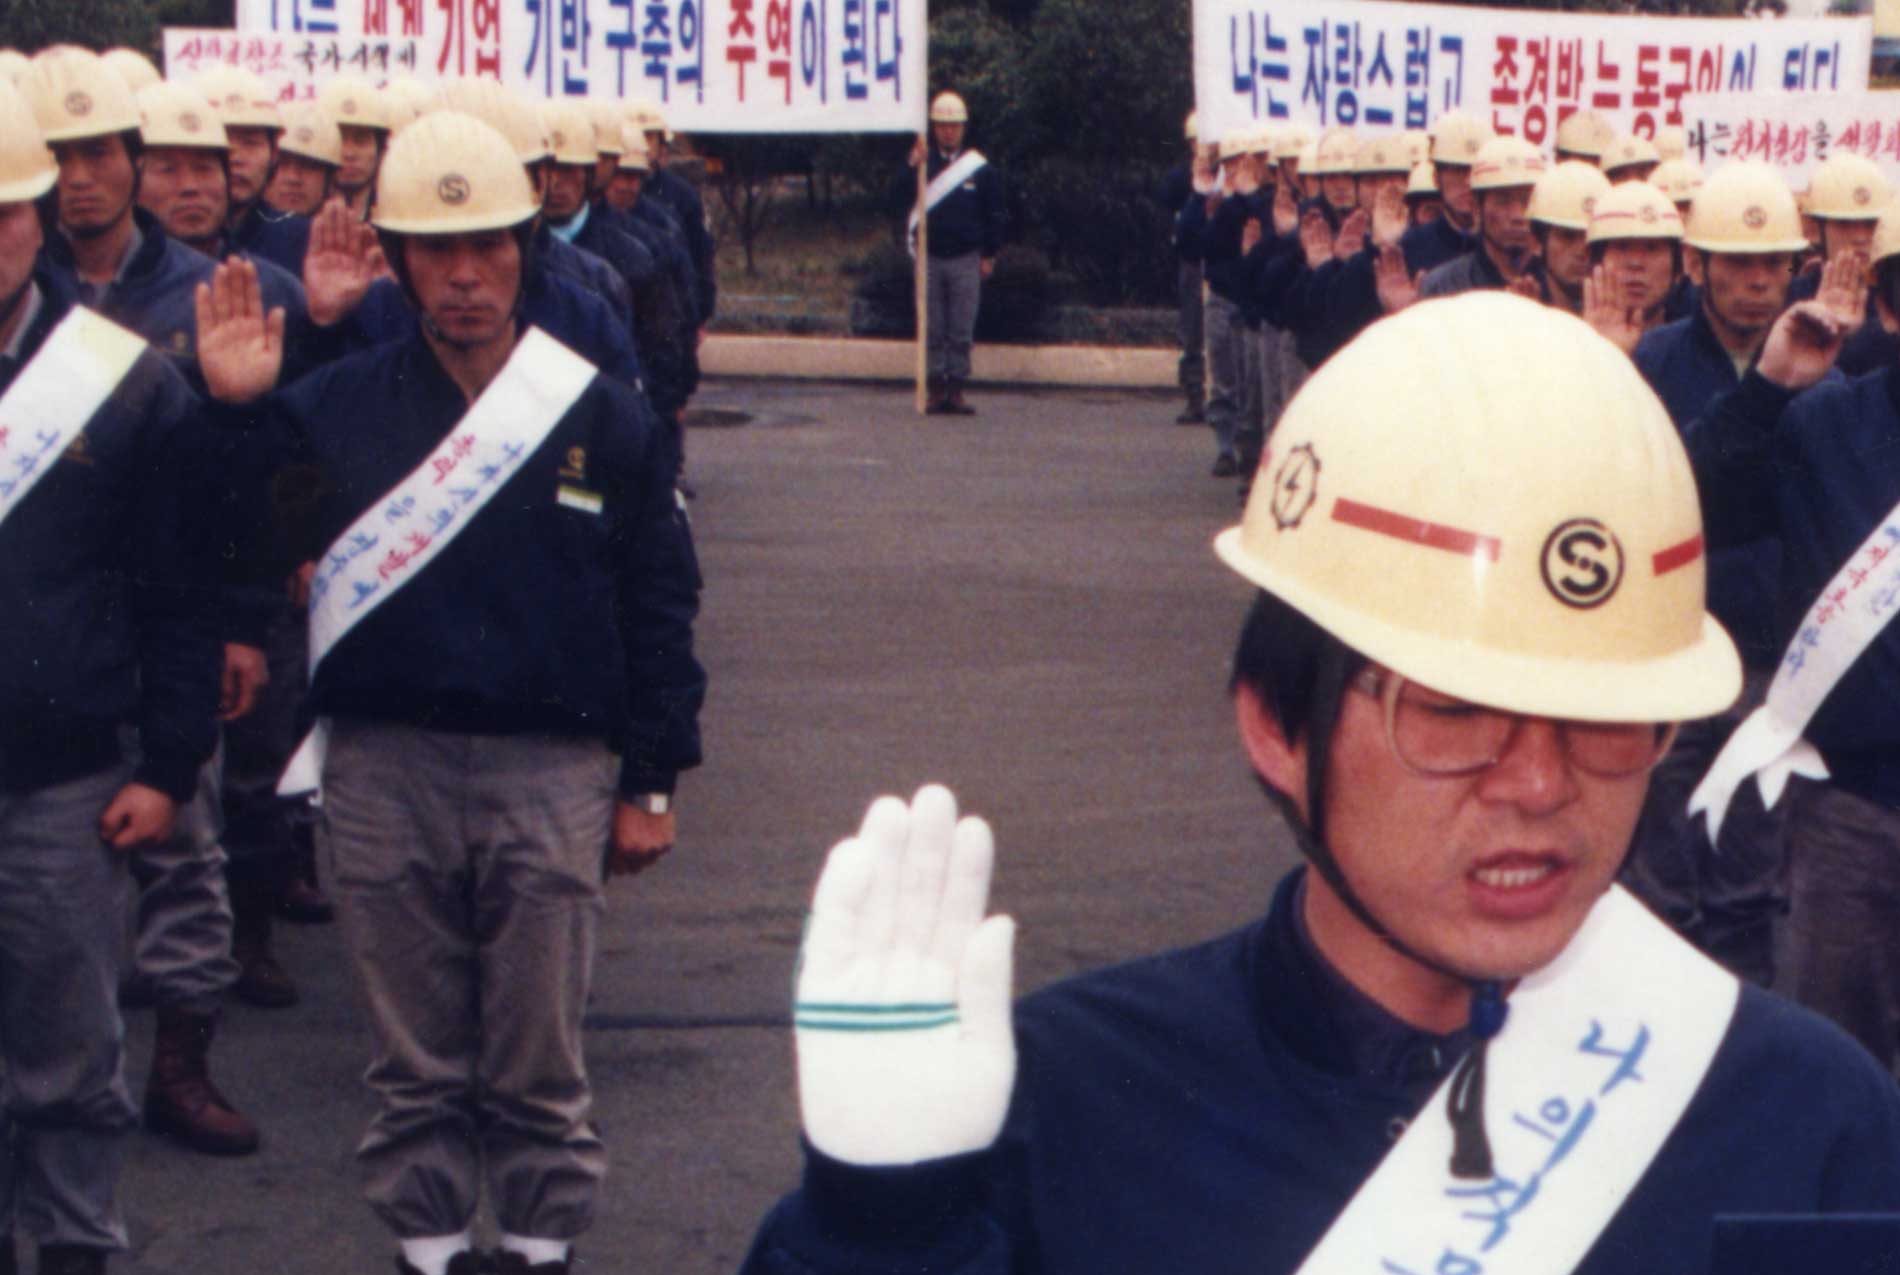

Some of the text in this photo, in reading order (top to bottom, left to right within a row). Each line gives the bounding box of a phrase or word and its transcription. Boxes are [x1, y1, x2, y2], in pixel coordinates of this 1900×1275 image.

[605, 0, 704, 104] 구축의
[1230, 10, 1290, 119] 나는
[1302, 18, 1463, 130] 자랑스럽고
[1554, 527, 1612, 600] S
